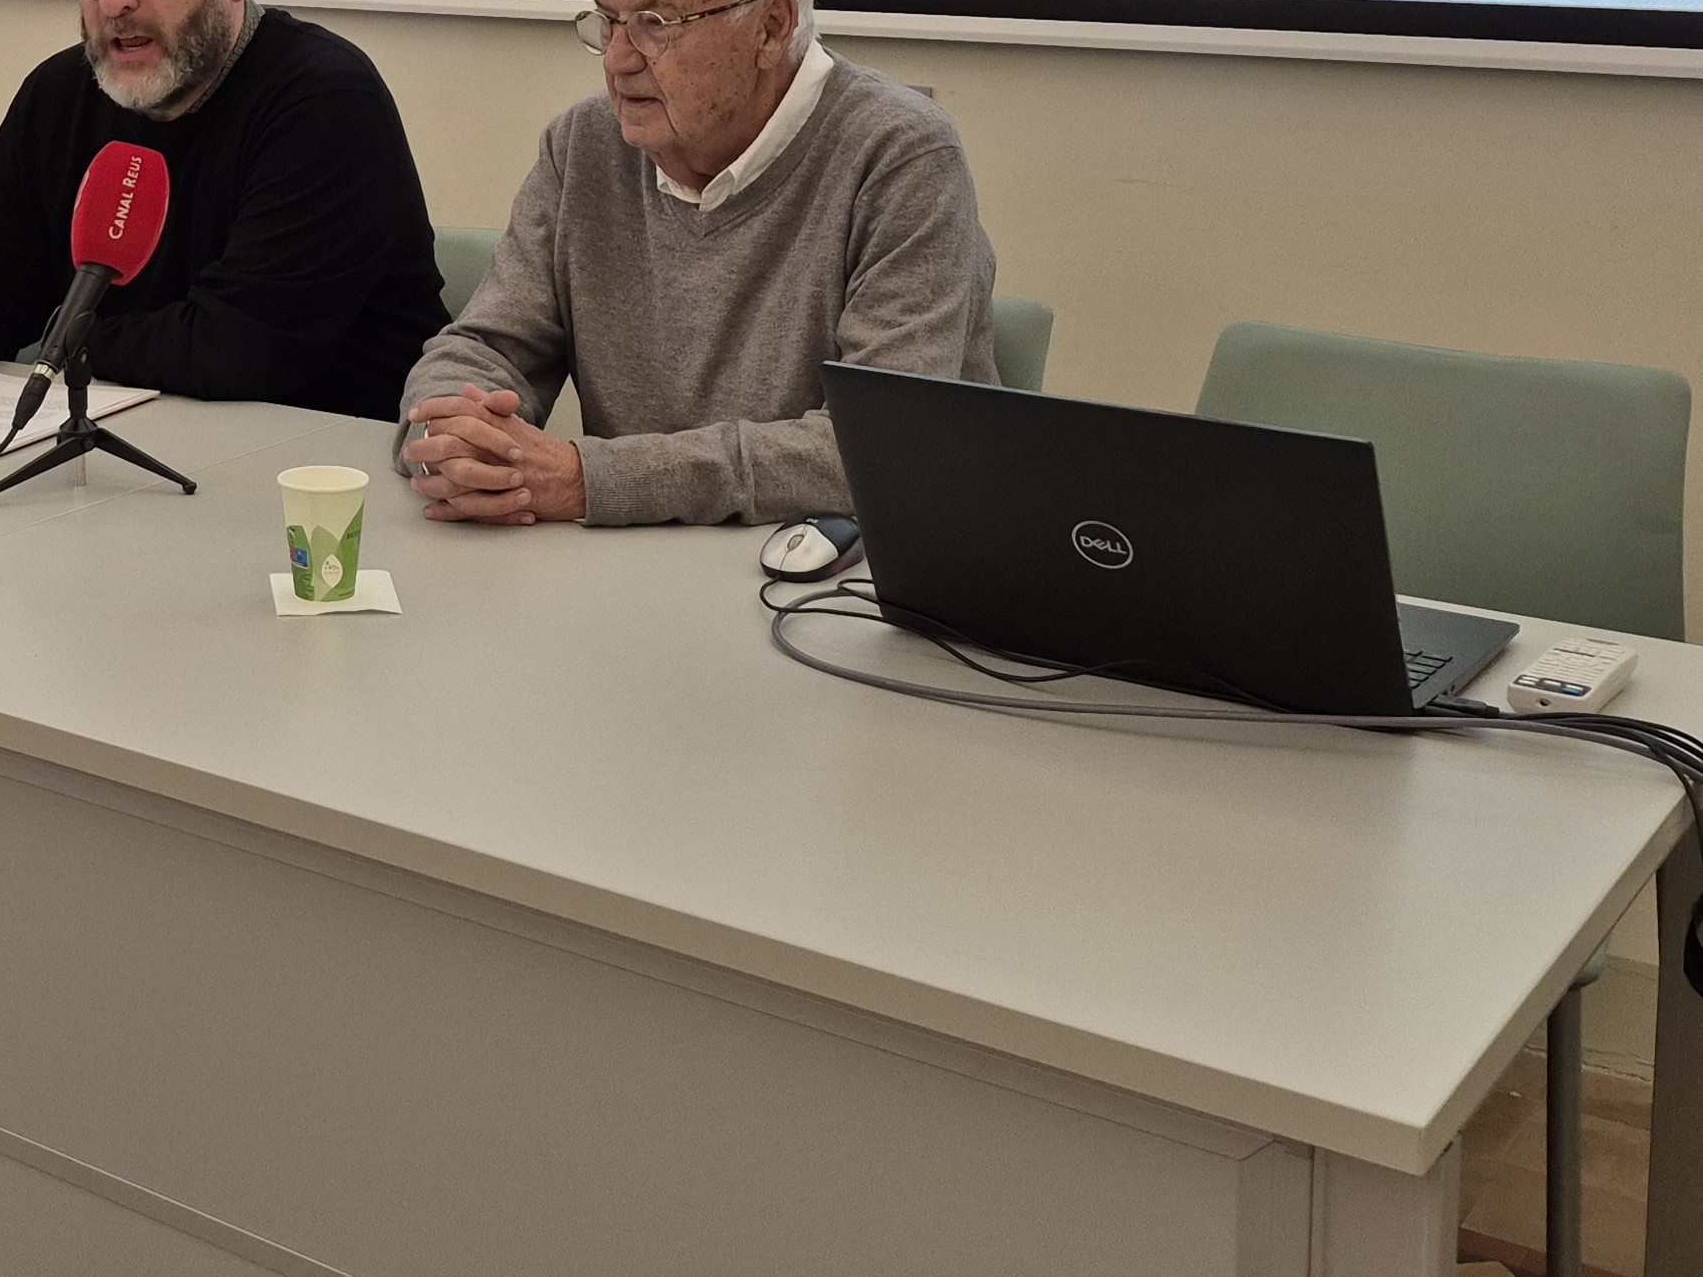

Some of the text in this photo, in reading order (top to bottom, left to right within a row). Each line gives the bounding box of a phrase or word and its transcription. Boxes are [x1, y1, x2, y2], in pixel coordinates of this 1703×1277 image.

[108, 155, 142, 240] CANAL REUS
[1079, 535, 1128, 555] DELL
